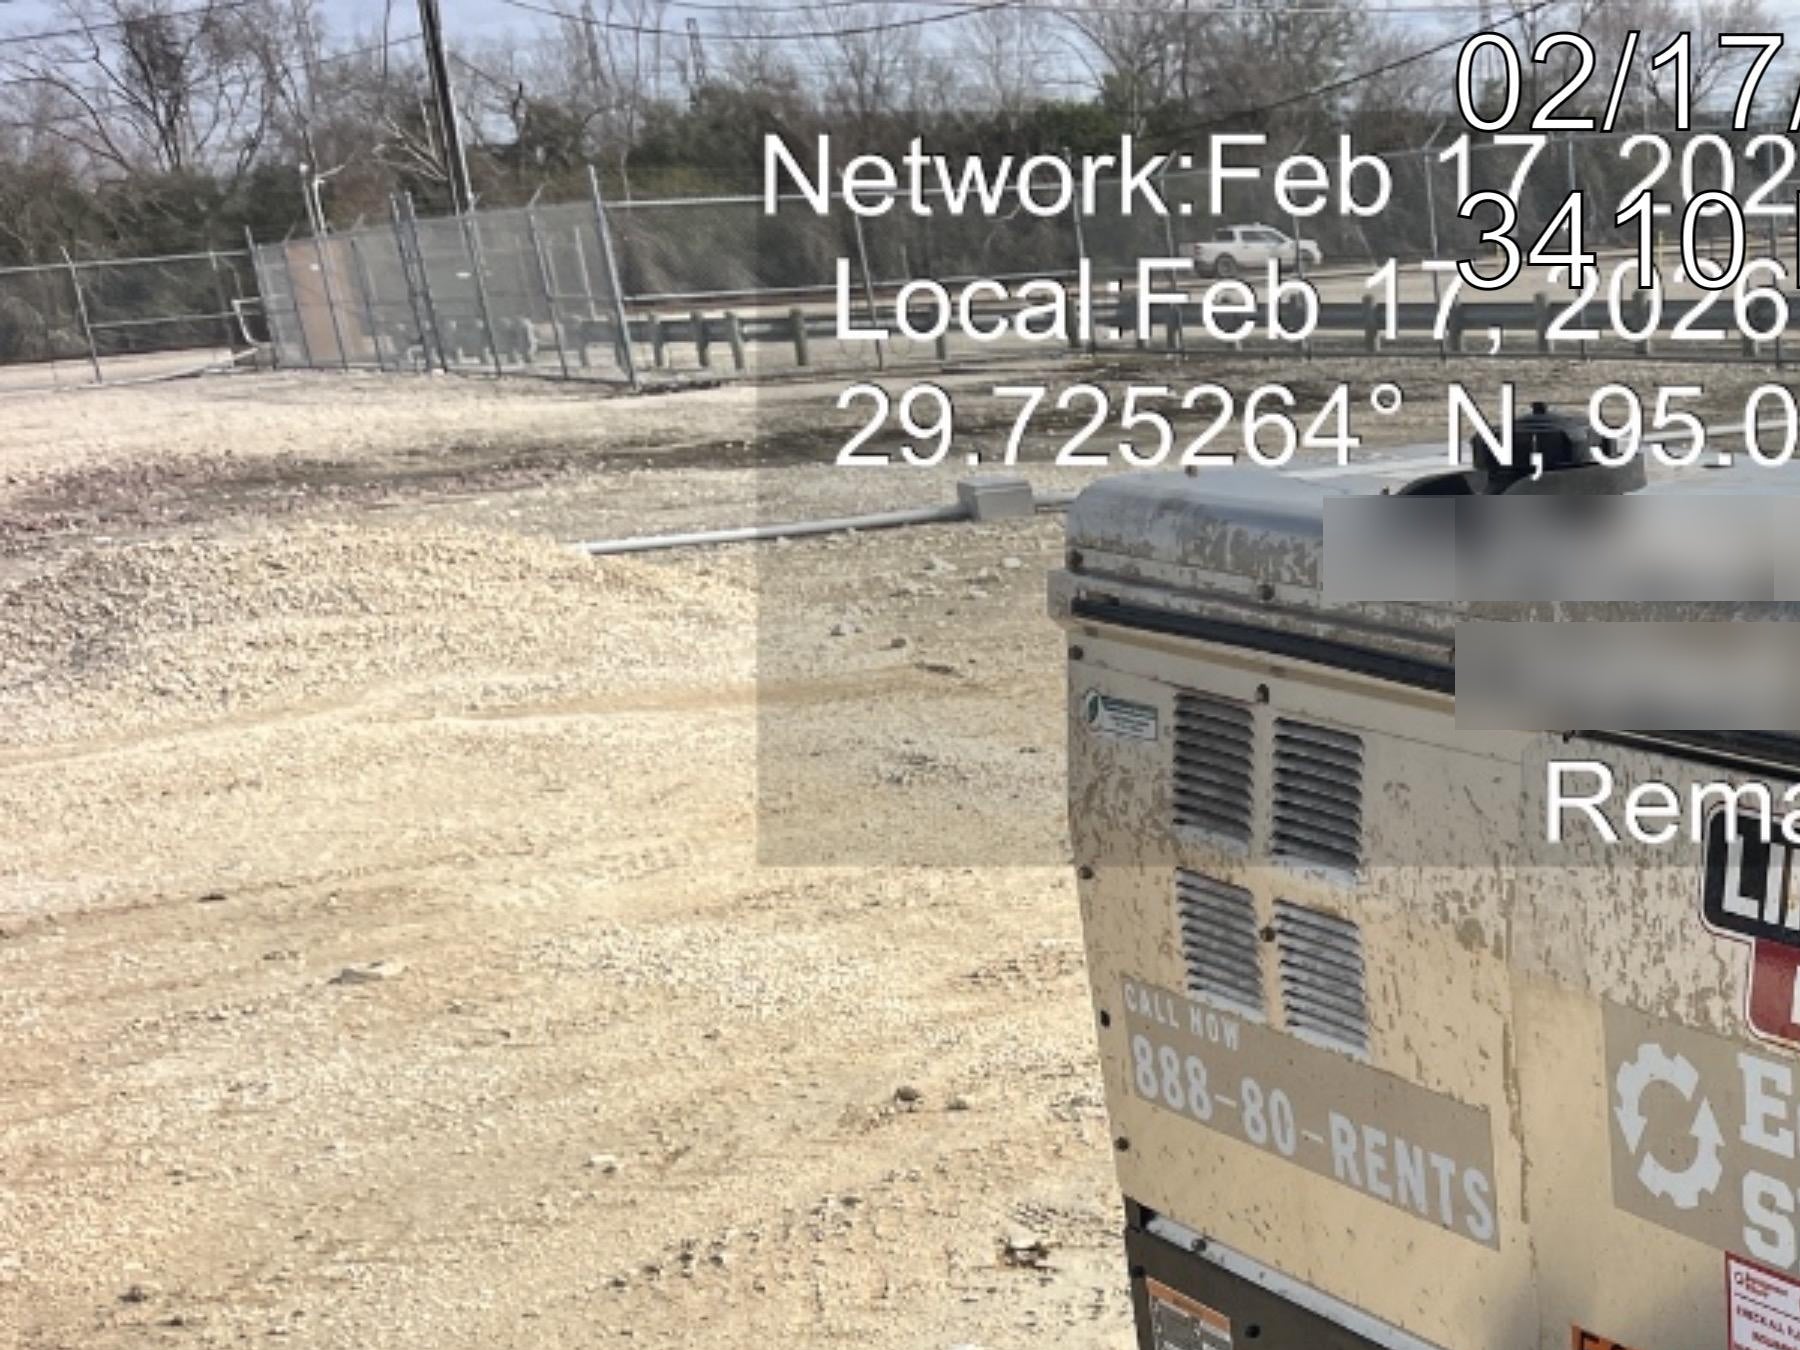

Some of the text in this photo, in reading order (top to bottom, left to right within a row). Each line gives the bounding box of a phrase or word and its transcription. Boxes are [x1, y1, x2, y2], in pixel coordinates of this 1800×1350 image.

[1124, 982, 1240, 1052] CALL NOW
[1132, 1033, 1496, 1242] 888-80-RENTS
